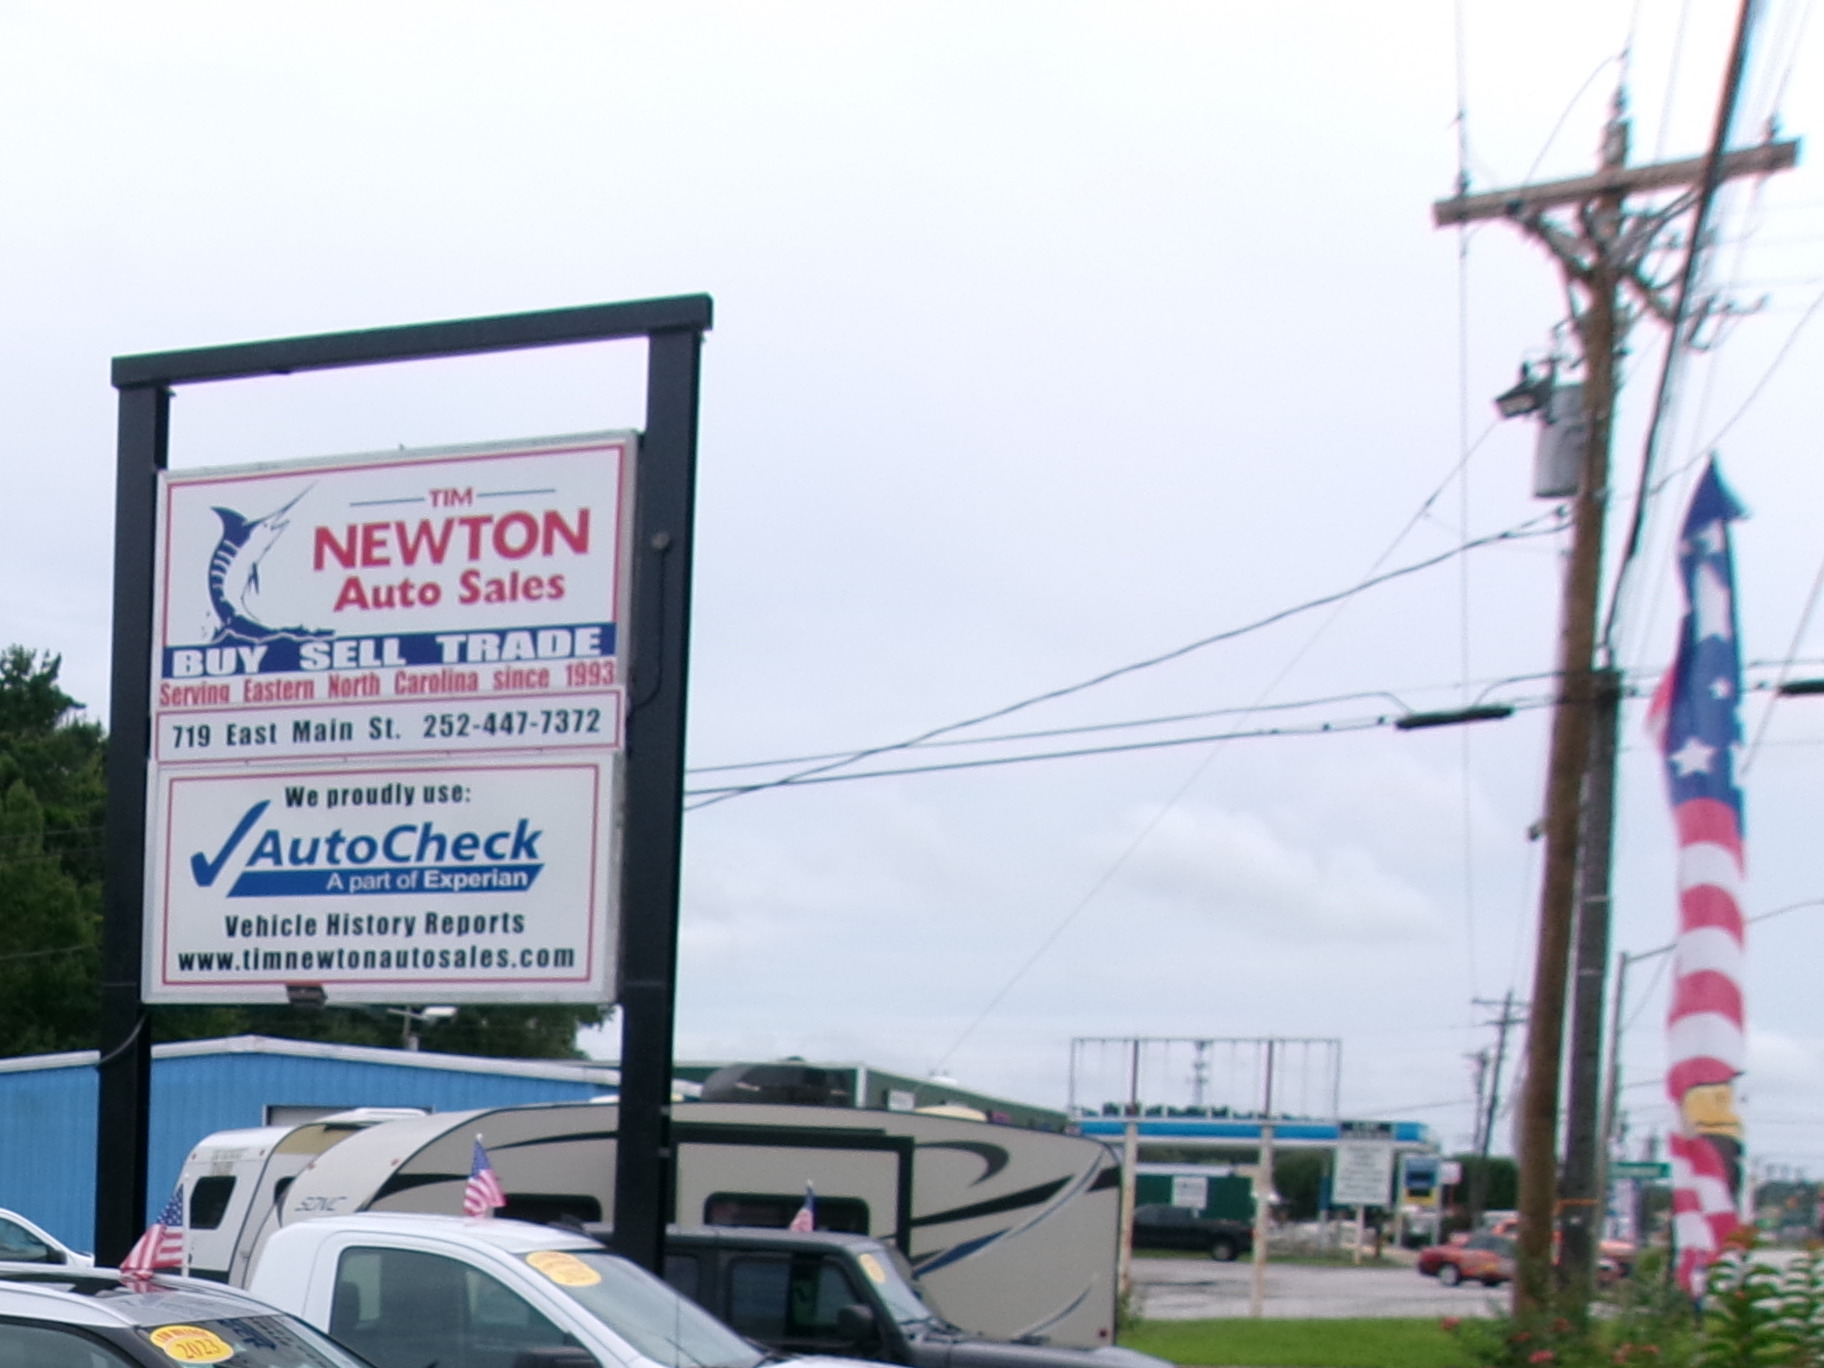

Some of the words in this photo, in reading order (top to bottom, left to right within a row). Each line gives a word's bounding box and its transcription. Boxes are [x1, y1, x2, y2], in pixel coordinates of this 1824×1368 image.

[430, 489, 474, 508] TIM
[313, 508, 591, 571] NEWTON
[334, 577, 441, 613] Auto
[459, 569, 566, 605] Sales
[172, 644, 269, 678] BUY
[299, 638, 406, 671] SELL
[436, 627, 602, 664] TRADE
[159, 683, 230, 707] Serving
[243, 679, 314, 702] Eastern
[328, 674, 381, 698] North
[395, 669, 478, 695] Carolina
[494, 665, 550, 690] since
[566, 661, 615, 687] 1993
[172, 724, 212, 749] 719
[225, 722, 277, 746] East
[292, 719, 353, 743] Main
[369, 716, 401, 740] St.
[423, 708, 601, 739] 252-447-7372
[285, 786, 318, 808] We
[328, 783, 415, 810] proudly
[423, 786, 471, 804] use:
[245, 818, 544, 868] AutoCheck
[327, 873, 345, 891] A
[349, 872, 392, 894] part
[396, 871, 418, 889] of
[423, 870, 528, 892] Experian
[225, 913, 317, 938] Vehicle
[326, 911, 417, 938] History
[425, 911, 526, 938] Reports
[178, 944, 576, 973] www.timnewtonautosales.com
[176, 1338, 221, 1360] 2023
